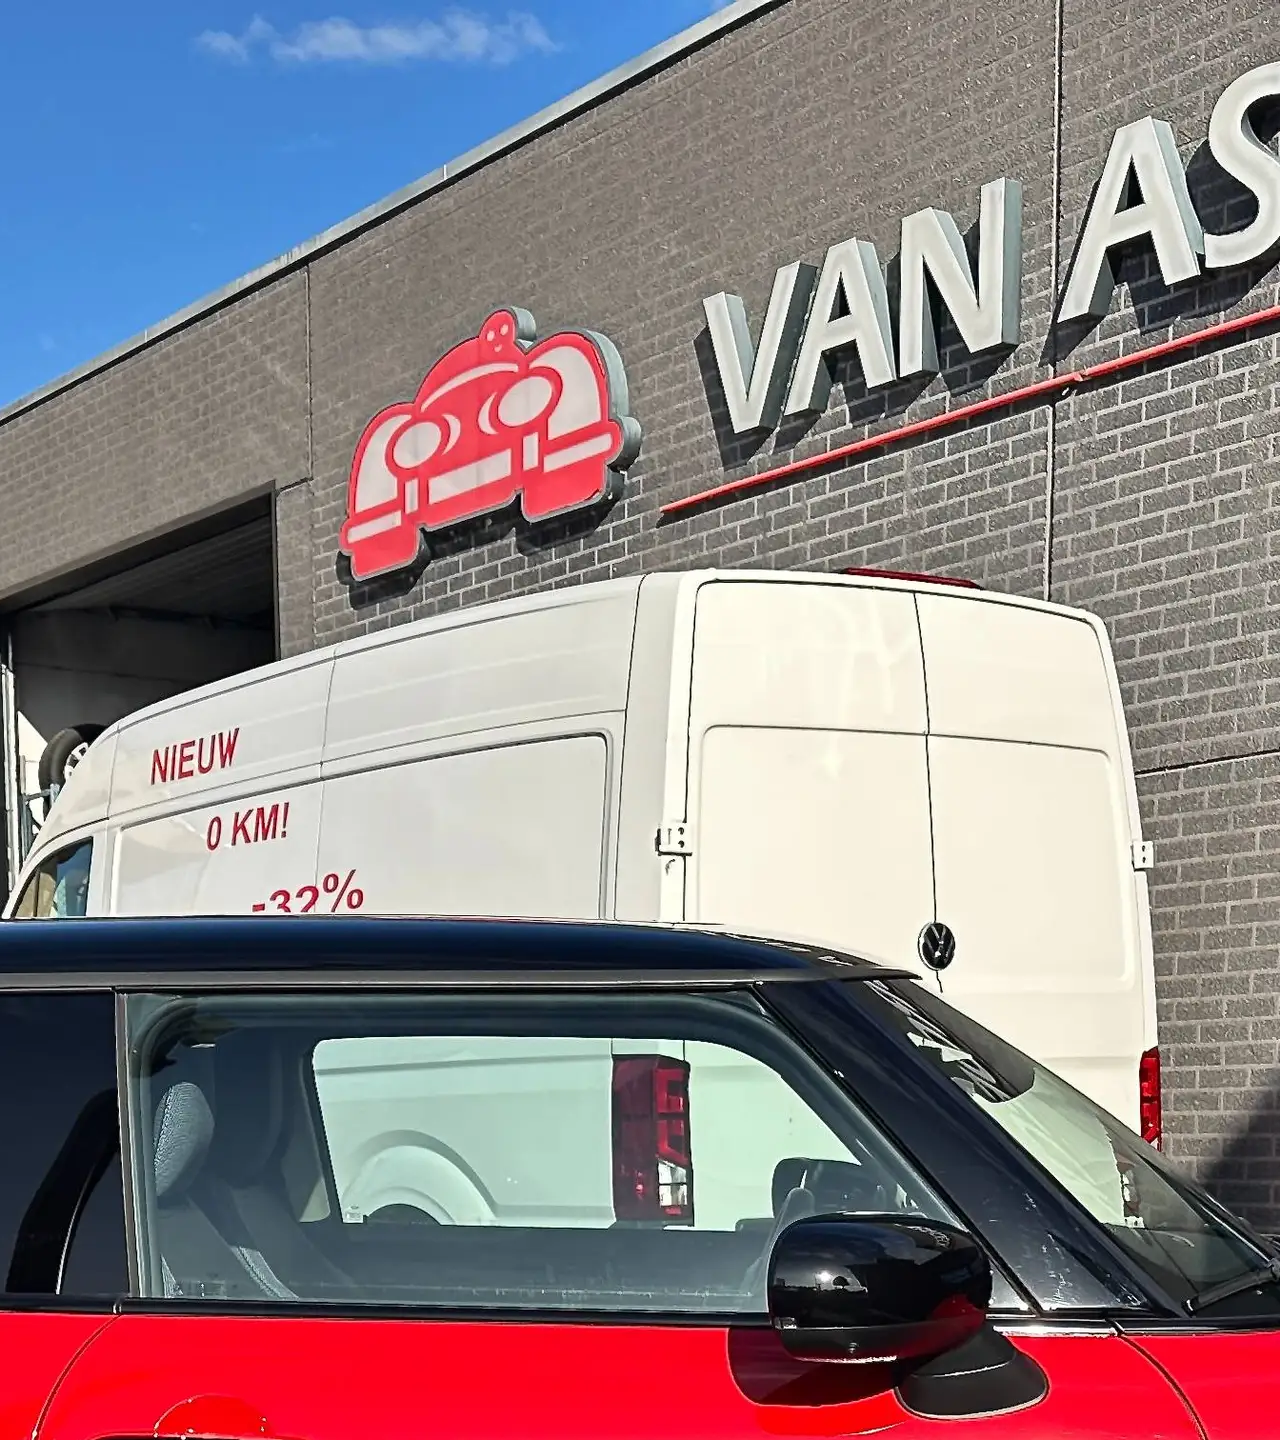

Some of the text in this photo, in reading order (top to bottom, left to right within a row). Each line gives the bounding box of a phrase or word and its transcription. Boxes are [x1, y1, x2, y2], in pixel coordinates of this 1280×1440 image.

[702, 176, 1020, 434] VAN
[150, 726, 240, 786] NIEUW
[206, 802, 290, 851] 0 KM!
